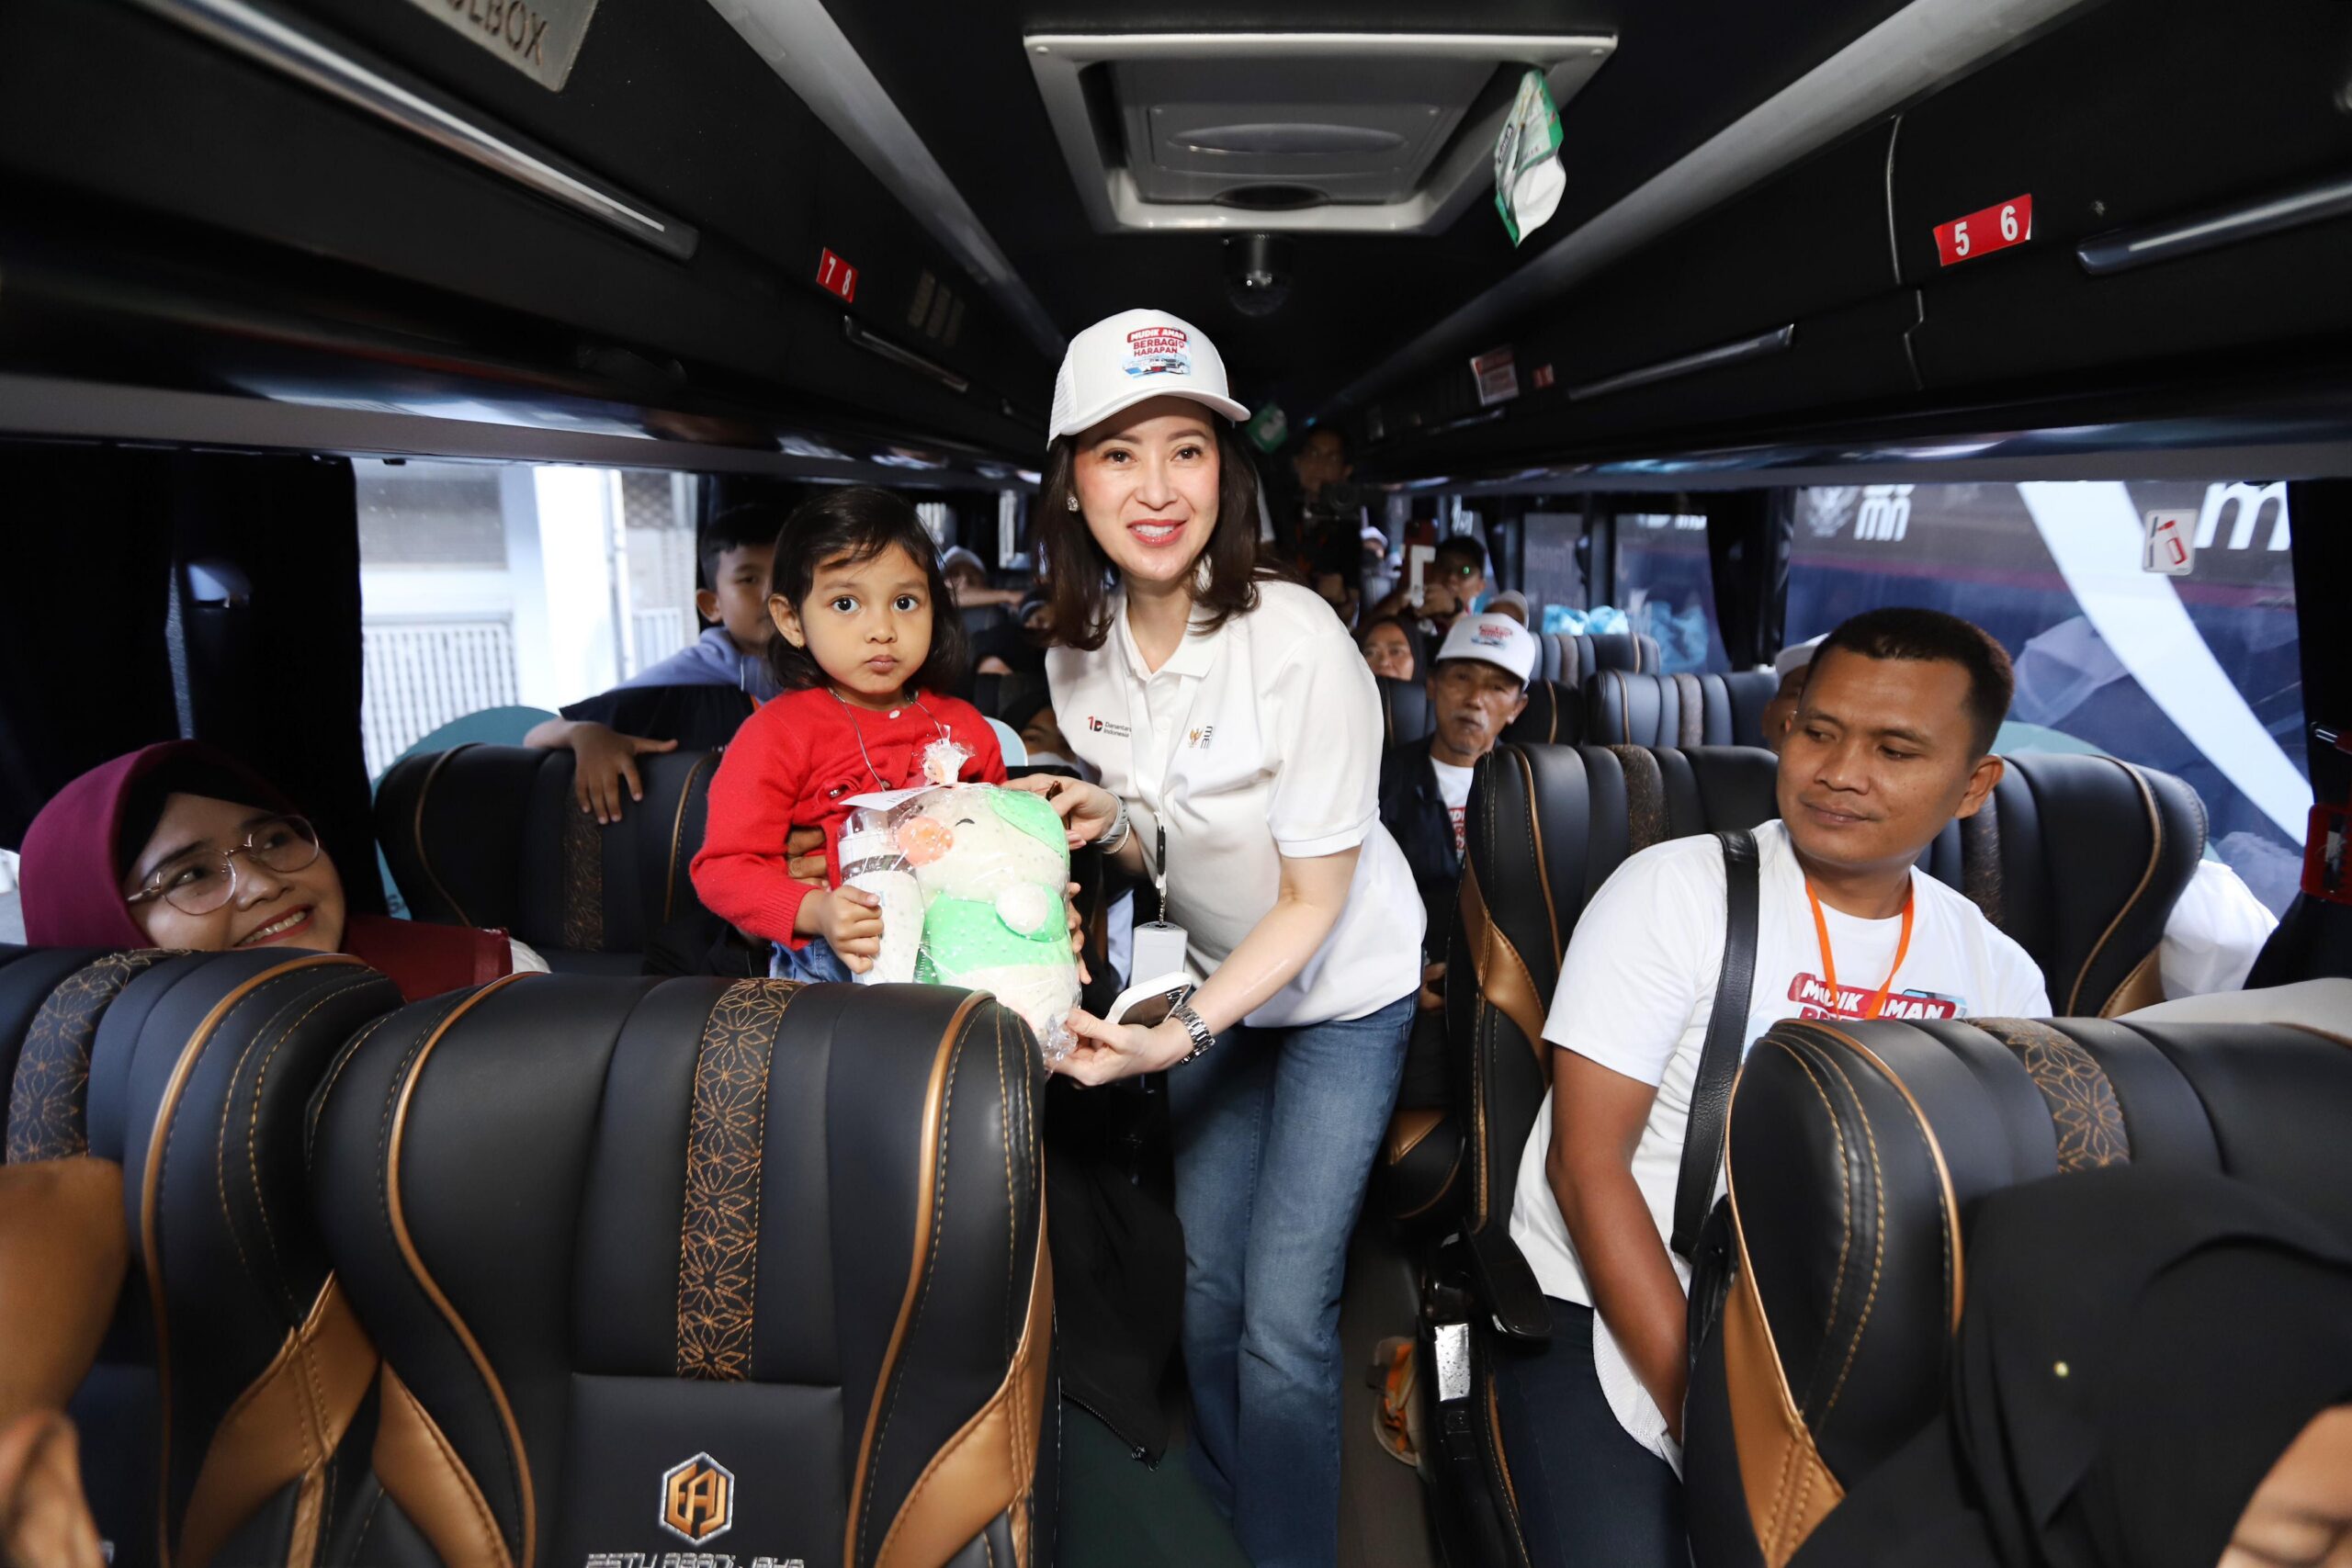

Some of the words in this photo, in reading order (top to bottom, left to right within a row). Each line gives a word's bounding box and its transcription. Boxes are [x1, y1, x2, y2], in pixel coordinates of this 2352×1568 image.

[1954, 221, 1970, 255] 5
[2000, 205, 2018, 242] 6
[825, 256, 836, 284] 7
[842, 269, 853, 295] 8
[1133, 338, 1178, 349] BERBAGI
[1134, 346, 1178, 356] HARAPAN
